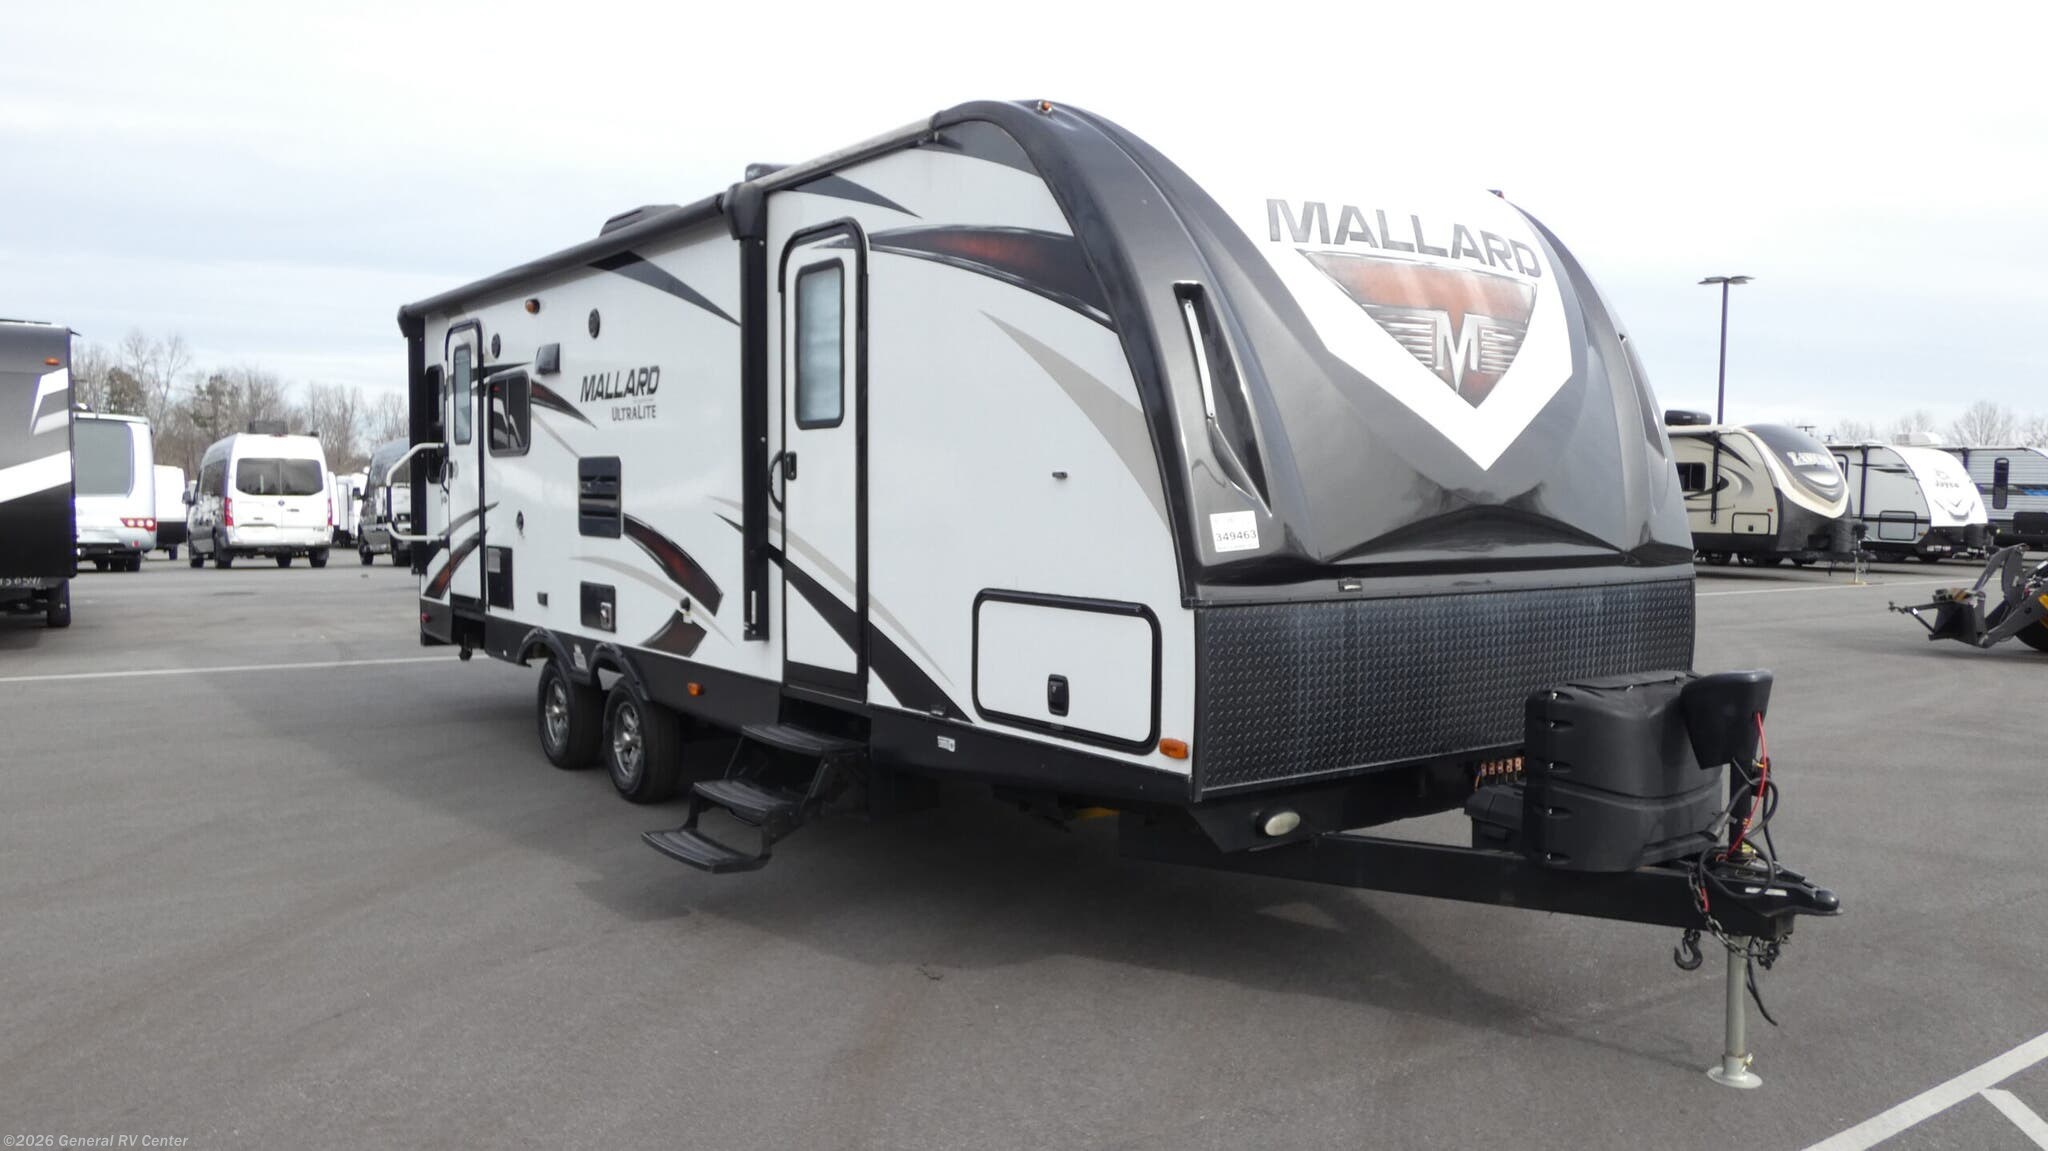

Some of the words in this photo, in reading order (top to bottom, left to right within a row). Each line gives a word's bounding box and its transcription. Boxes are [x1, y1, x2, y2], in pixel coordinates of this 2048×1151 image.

[1266, 198, 1542, 278] MALLARD
[580, 365, 661, 402] MALLARD
[1215, 529, 1257, 541] 349463
